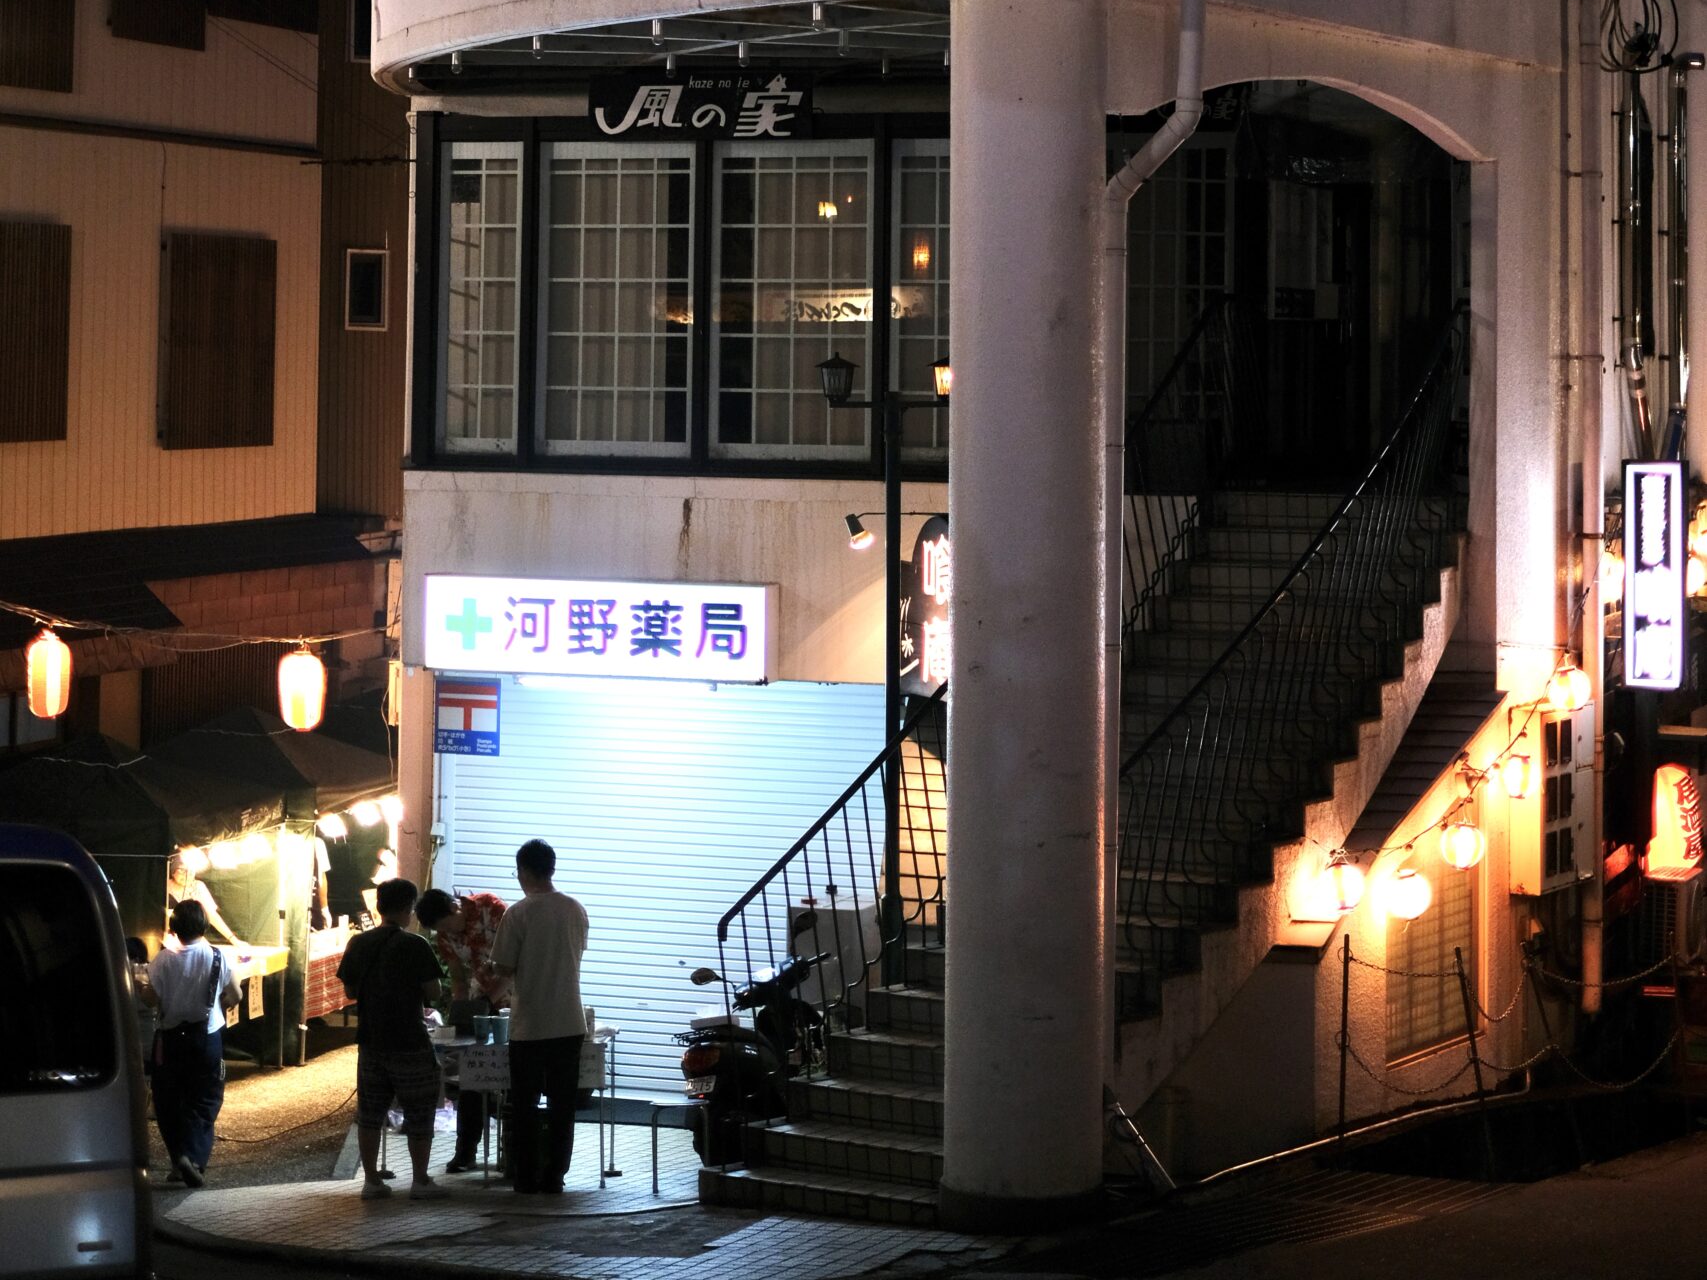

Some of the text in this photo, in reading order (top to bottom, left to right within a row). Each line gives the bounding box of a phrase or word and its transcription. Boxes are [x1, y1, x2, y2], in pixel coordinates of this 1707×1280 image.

[594, 74, 803, 137] 風の家
[688, 75, 713, 89] kaze
[737, 76, 750, 88] ie
[503, 596, 748, 661] 河野薬局
[1673, 776, 1703, 860] 居酒屋
